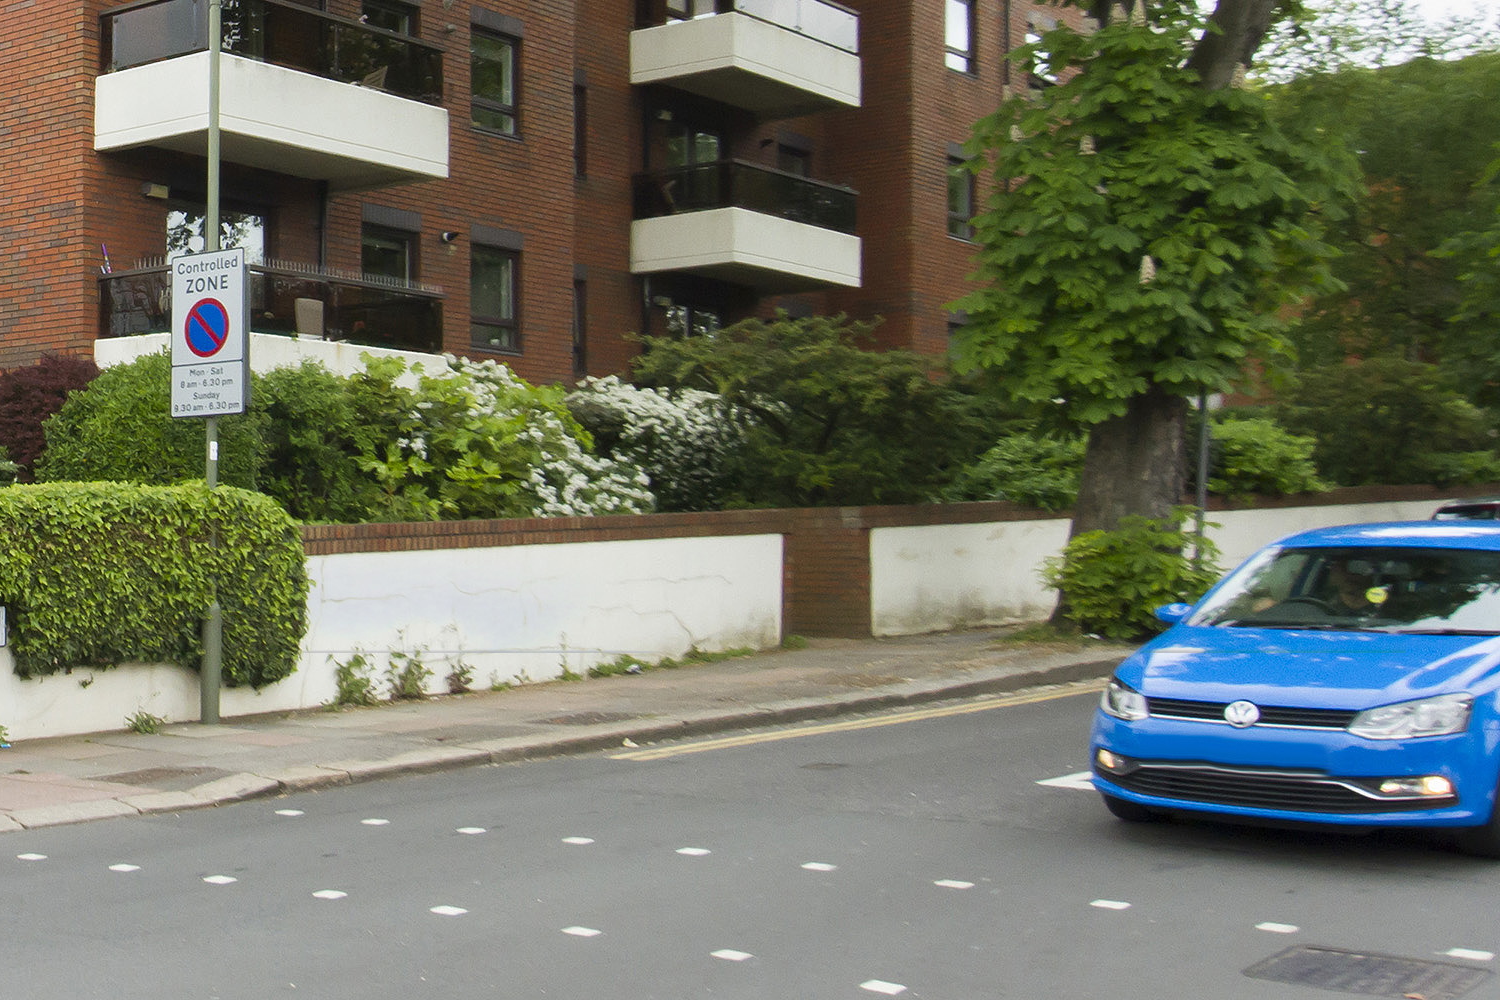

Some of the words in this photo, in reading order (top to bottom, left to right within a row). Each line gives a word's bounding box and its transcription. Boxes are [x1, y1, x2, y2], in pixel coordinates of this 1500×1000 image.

[177, 256, 238, 275] Controlled
[186, 275, 228, 294] ZONE
[210, 367, 224, 375] Sat
[222, 378, 233, 386] pm
[192, 391, 220, 400] Sunday
[228, 401, 240, 410] pm
